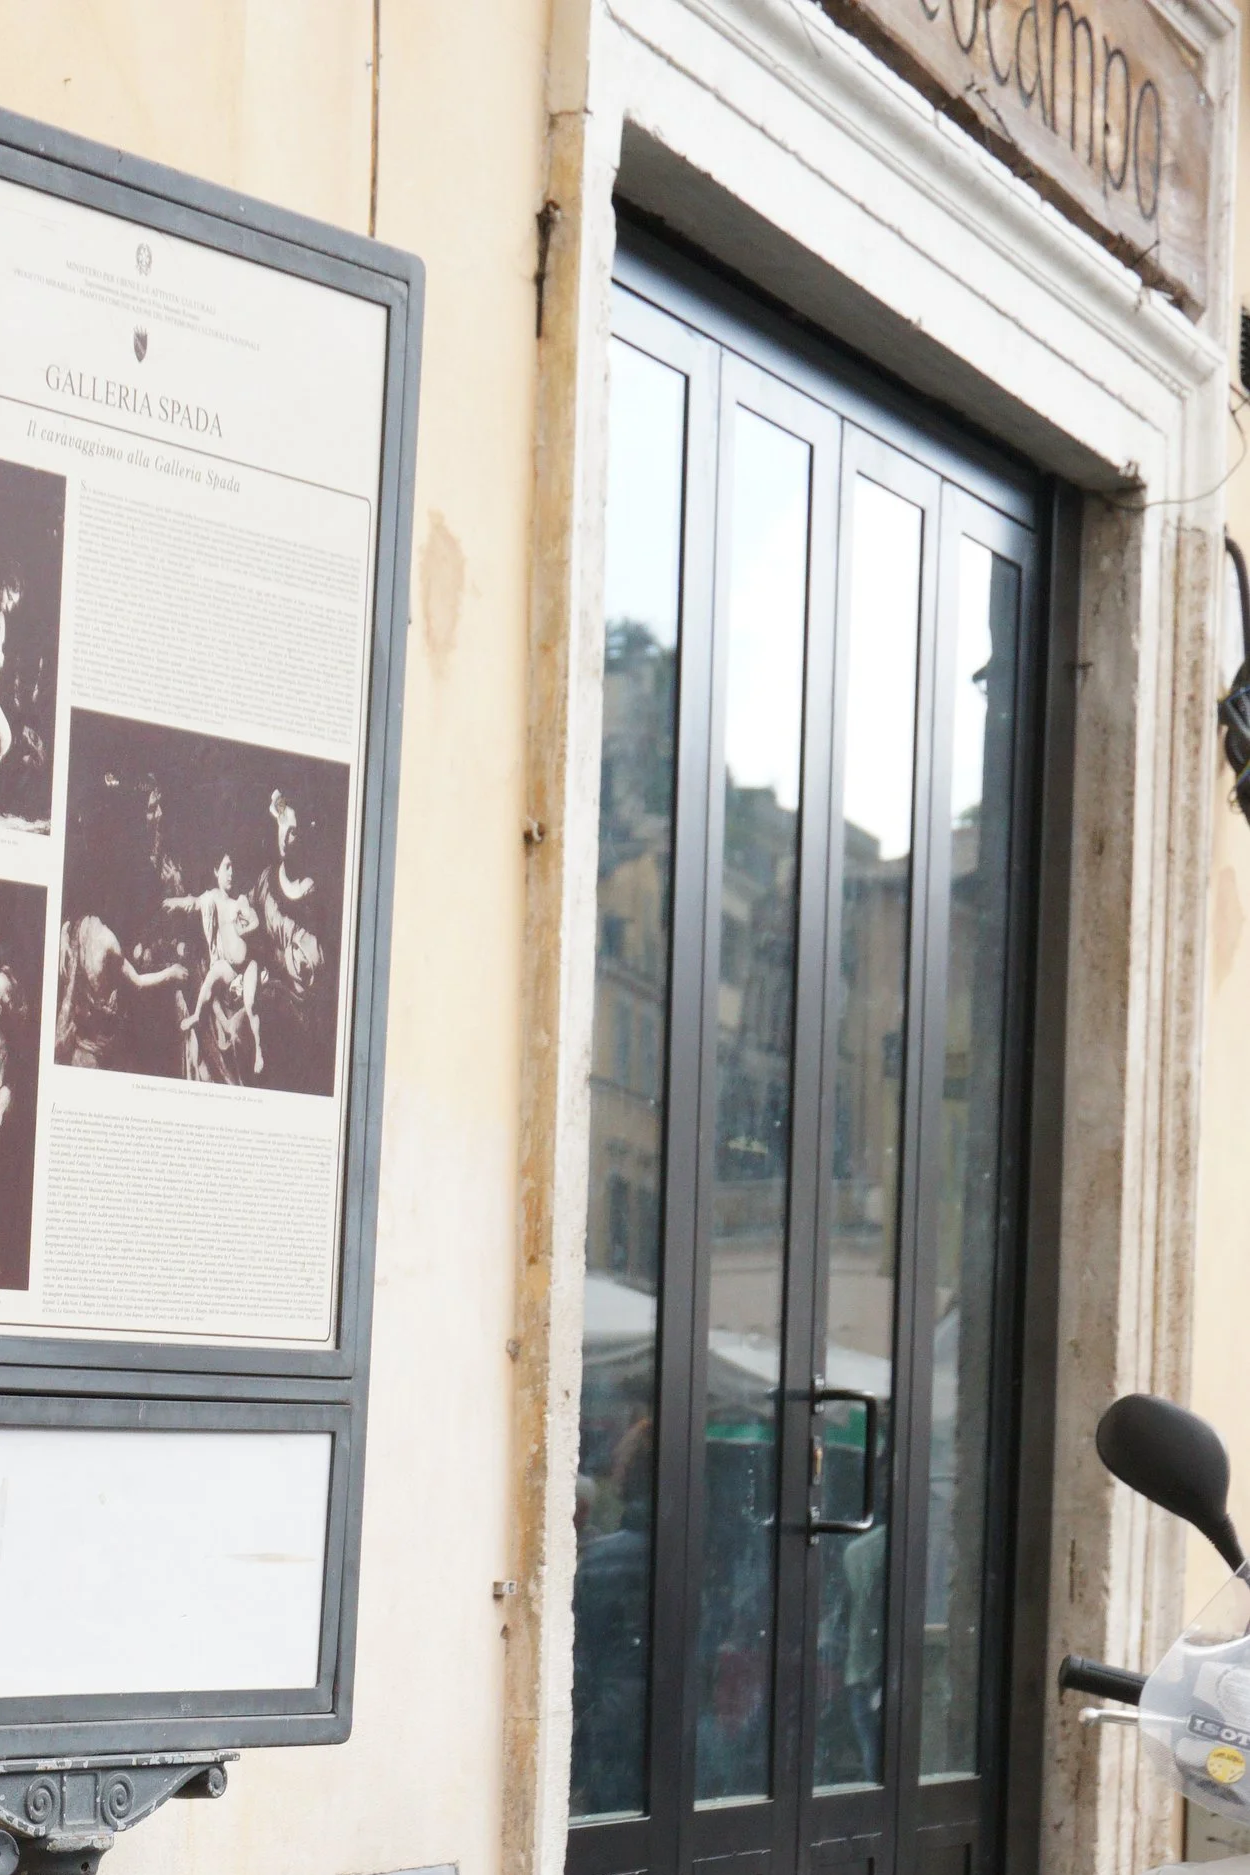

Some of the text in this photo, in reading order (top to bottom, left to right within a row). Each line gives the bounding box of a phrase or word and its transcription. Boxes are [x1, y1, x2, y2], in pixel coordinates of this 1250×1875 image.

[45, 363, 223, 438] GALLERIA SPADA
[26, 419, 241, 493] Il caravaggismo alla Galleria Spada
